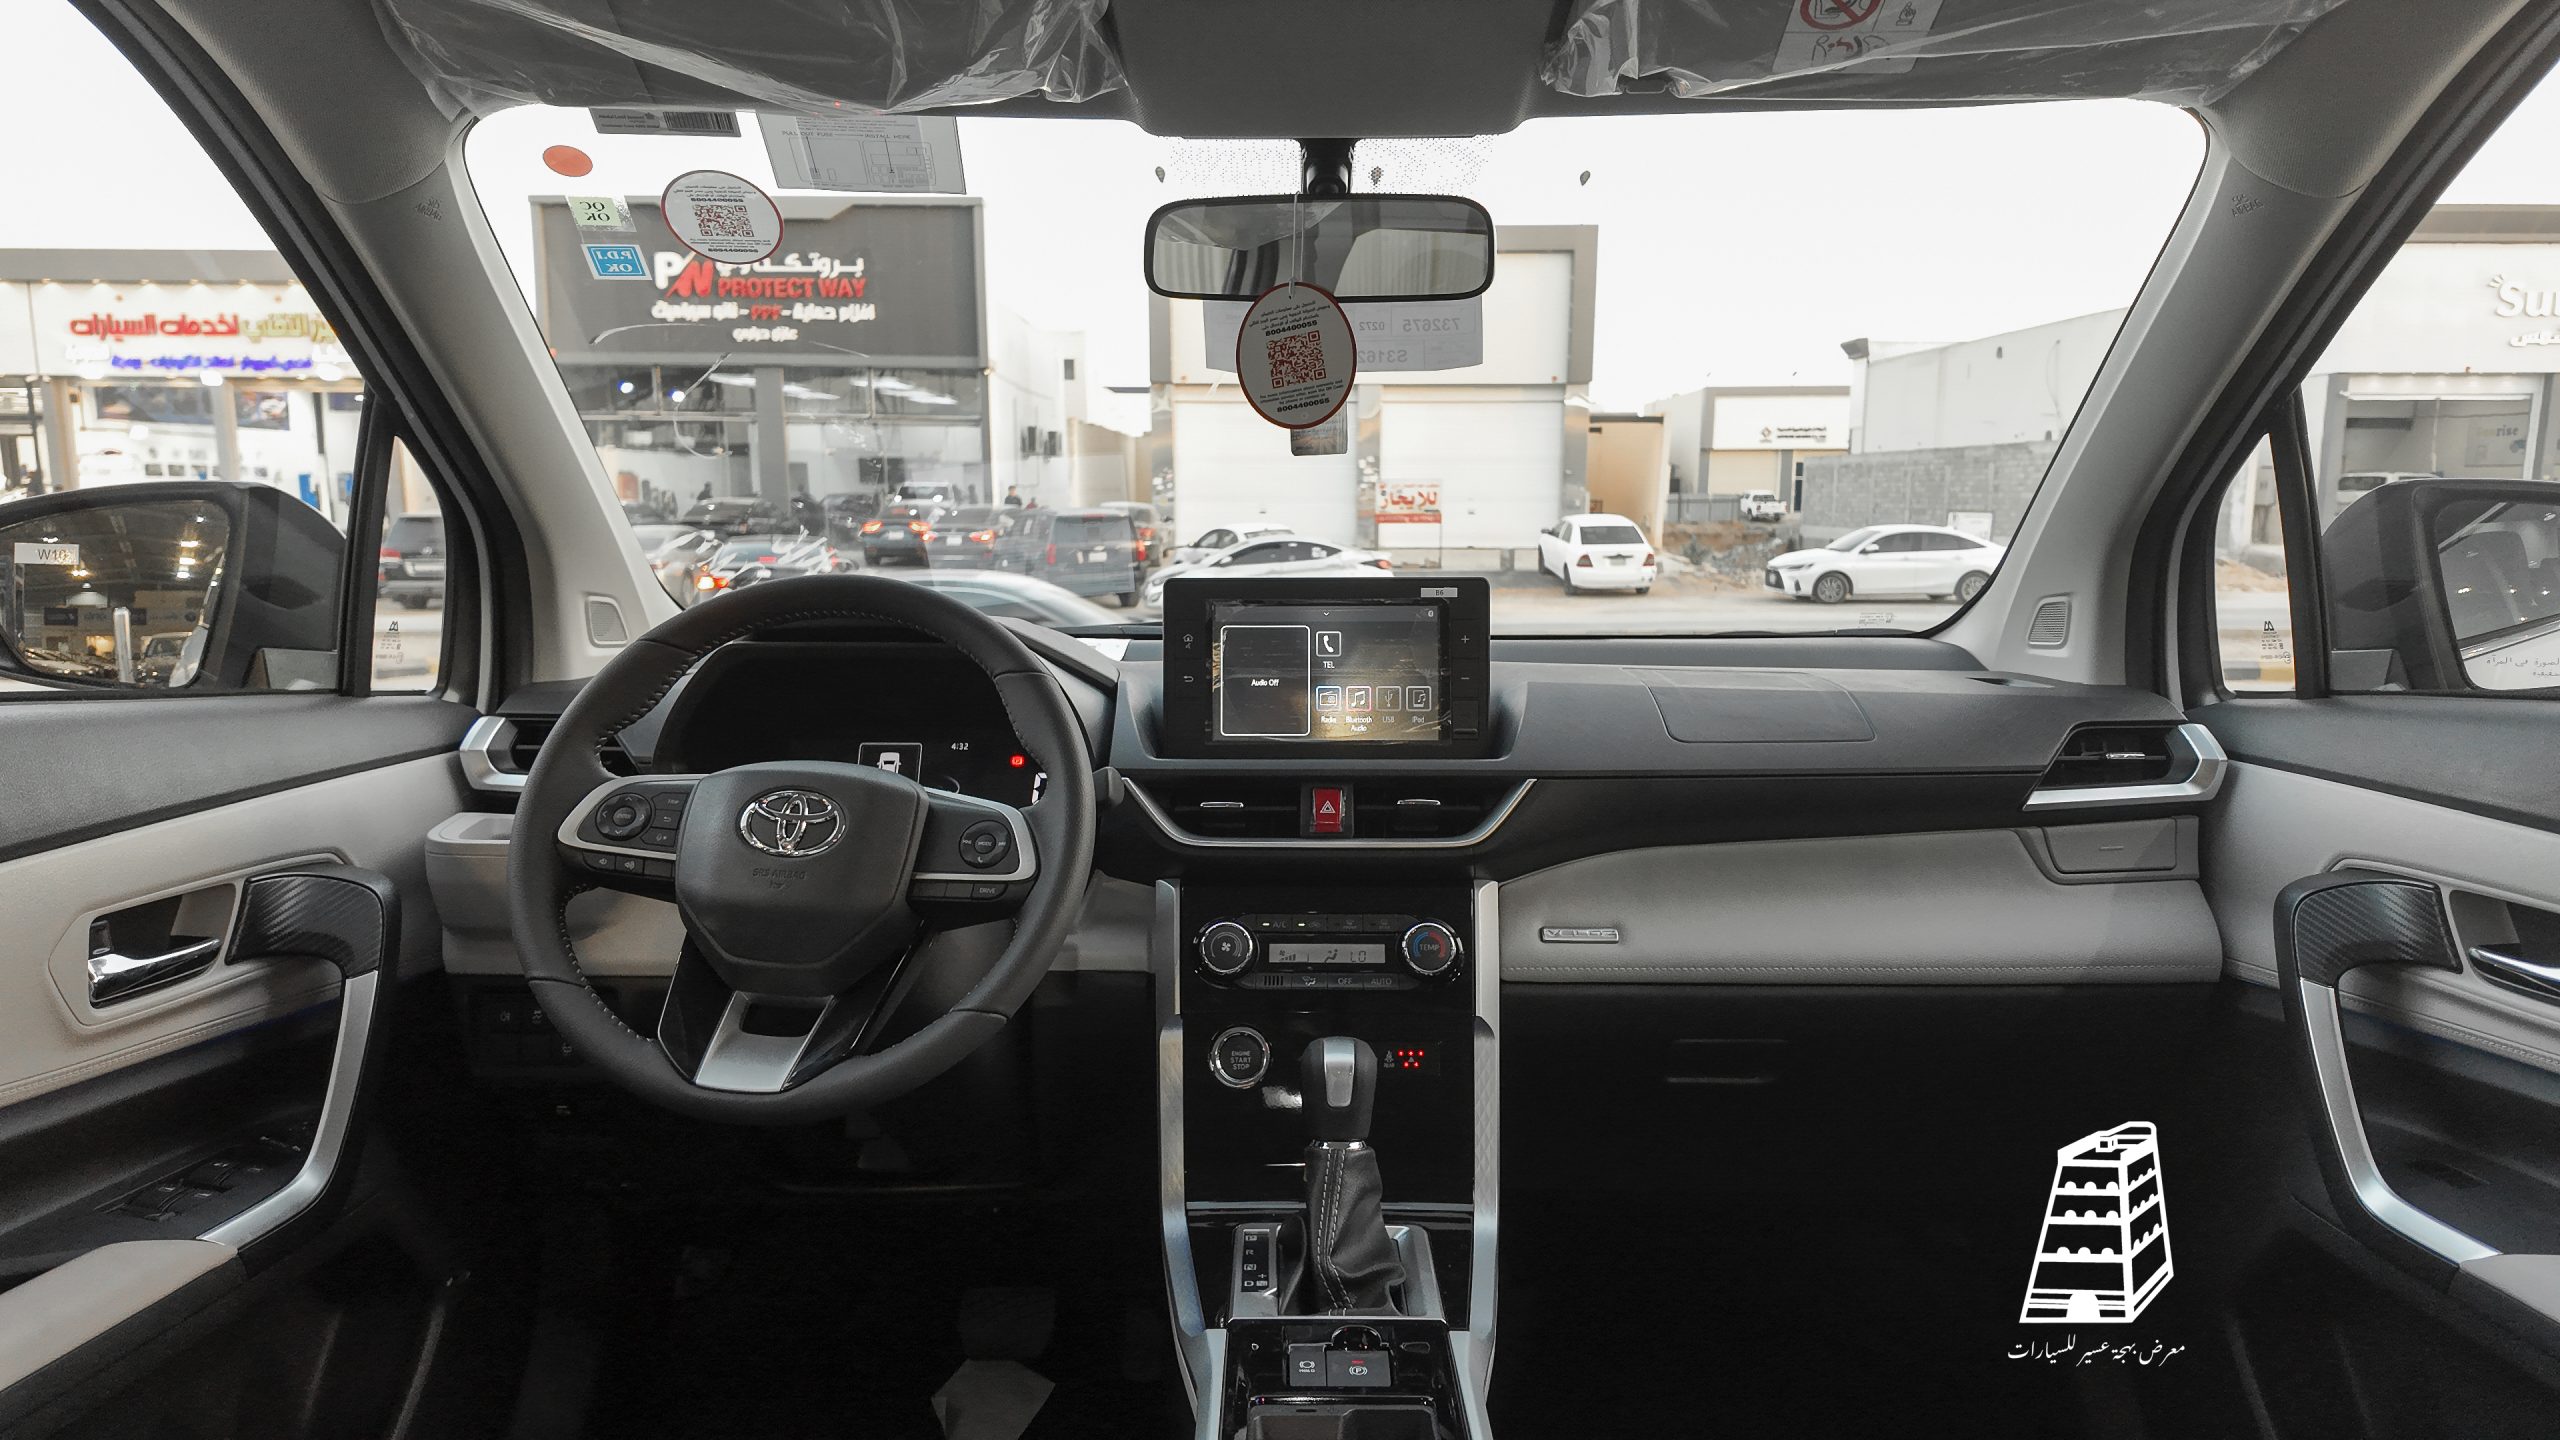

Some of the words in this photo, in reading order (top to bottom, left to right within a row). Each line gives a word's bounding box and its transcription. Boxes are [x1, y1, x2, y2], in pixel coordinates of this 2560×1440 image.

[718, 276, 815, 298] PROTECT
[819, 276, 867, 298] WAY
[69, 314, 157, 342] السيارات
[1322, 660, 1336, 669] TEL
[1250, 678, 1268, 687] Audio
[1268, 678, 1280, 687] Off
[1320, 715, 1337, 724] Radio
[1345, 715, 1373, 724] Bluetooth
[1411, 716, 1425, 724] iPod
[1350, 725, 1367, 733] Audio
[951, 743, 969, 751] 4:32
[1273, 920, 1288, 929] A/C
[1420, 943, 1441, 951] TEMP
[1337, 977, 1354, 985] OFF
[1370, 977, 1393, 985] AUTO
[1230, 1056, 1252, 1064] START
[1232, 1063, 1251, 1071] STOP
